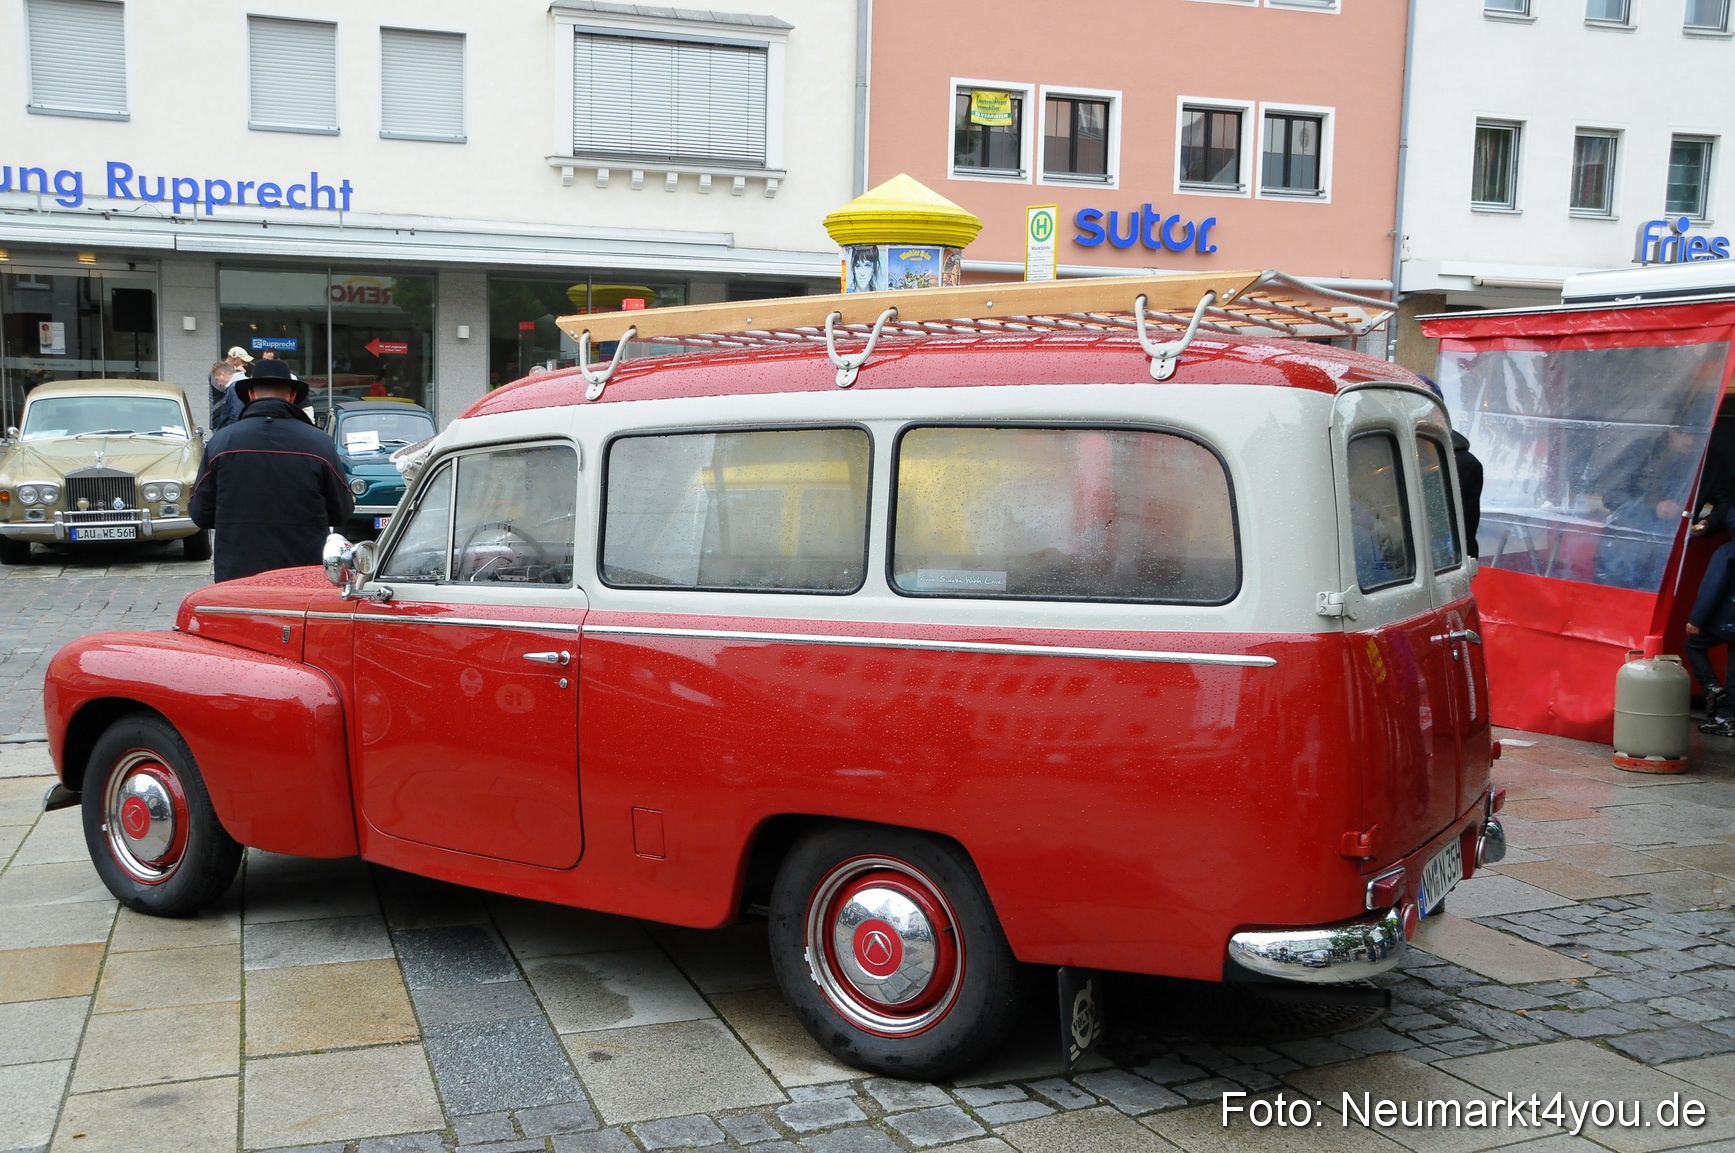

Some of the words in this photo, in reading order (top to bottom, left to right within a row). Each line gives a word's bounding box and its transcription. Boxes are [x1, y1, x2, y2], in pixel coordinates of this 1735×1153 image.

[106, 161, 354, 215] Rupprecht
[1036, 218, 1047, 235] H
[1636, 216, 1731, 263] fries
[262, 340, 296, 349] Rupprecht
[77, 530, 96, 539] LAU
[117, 528, 135, 538] 56H
[1422, 863, 1435, 907] NM
[1438, 854, 1447, 891] N
